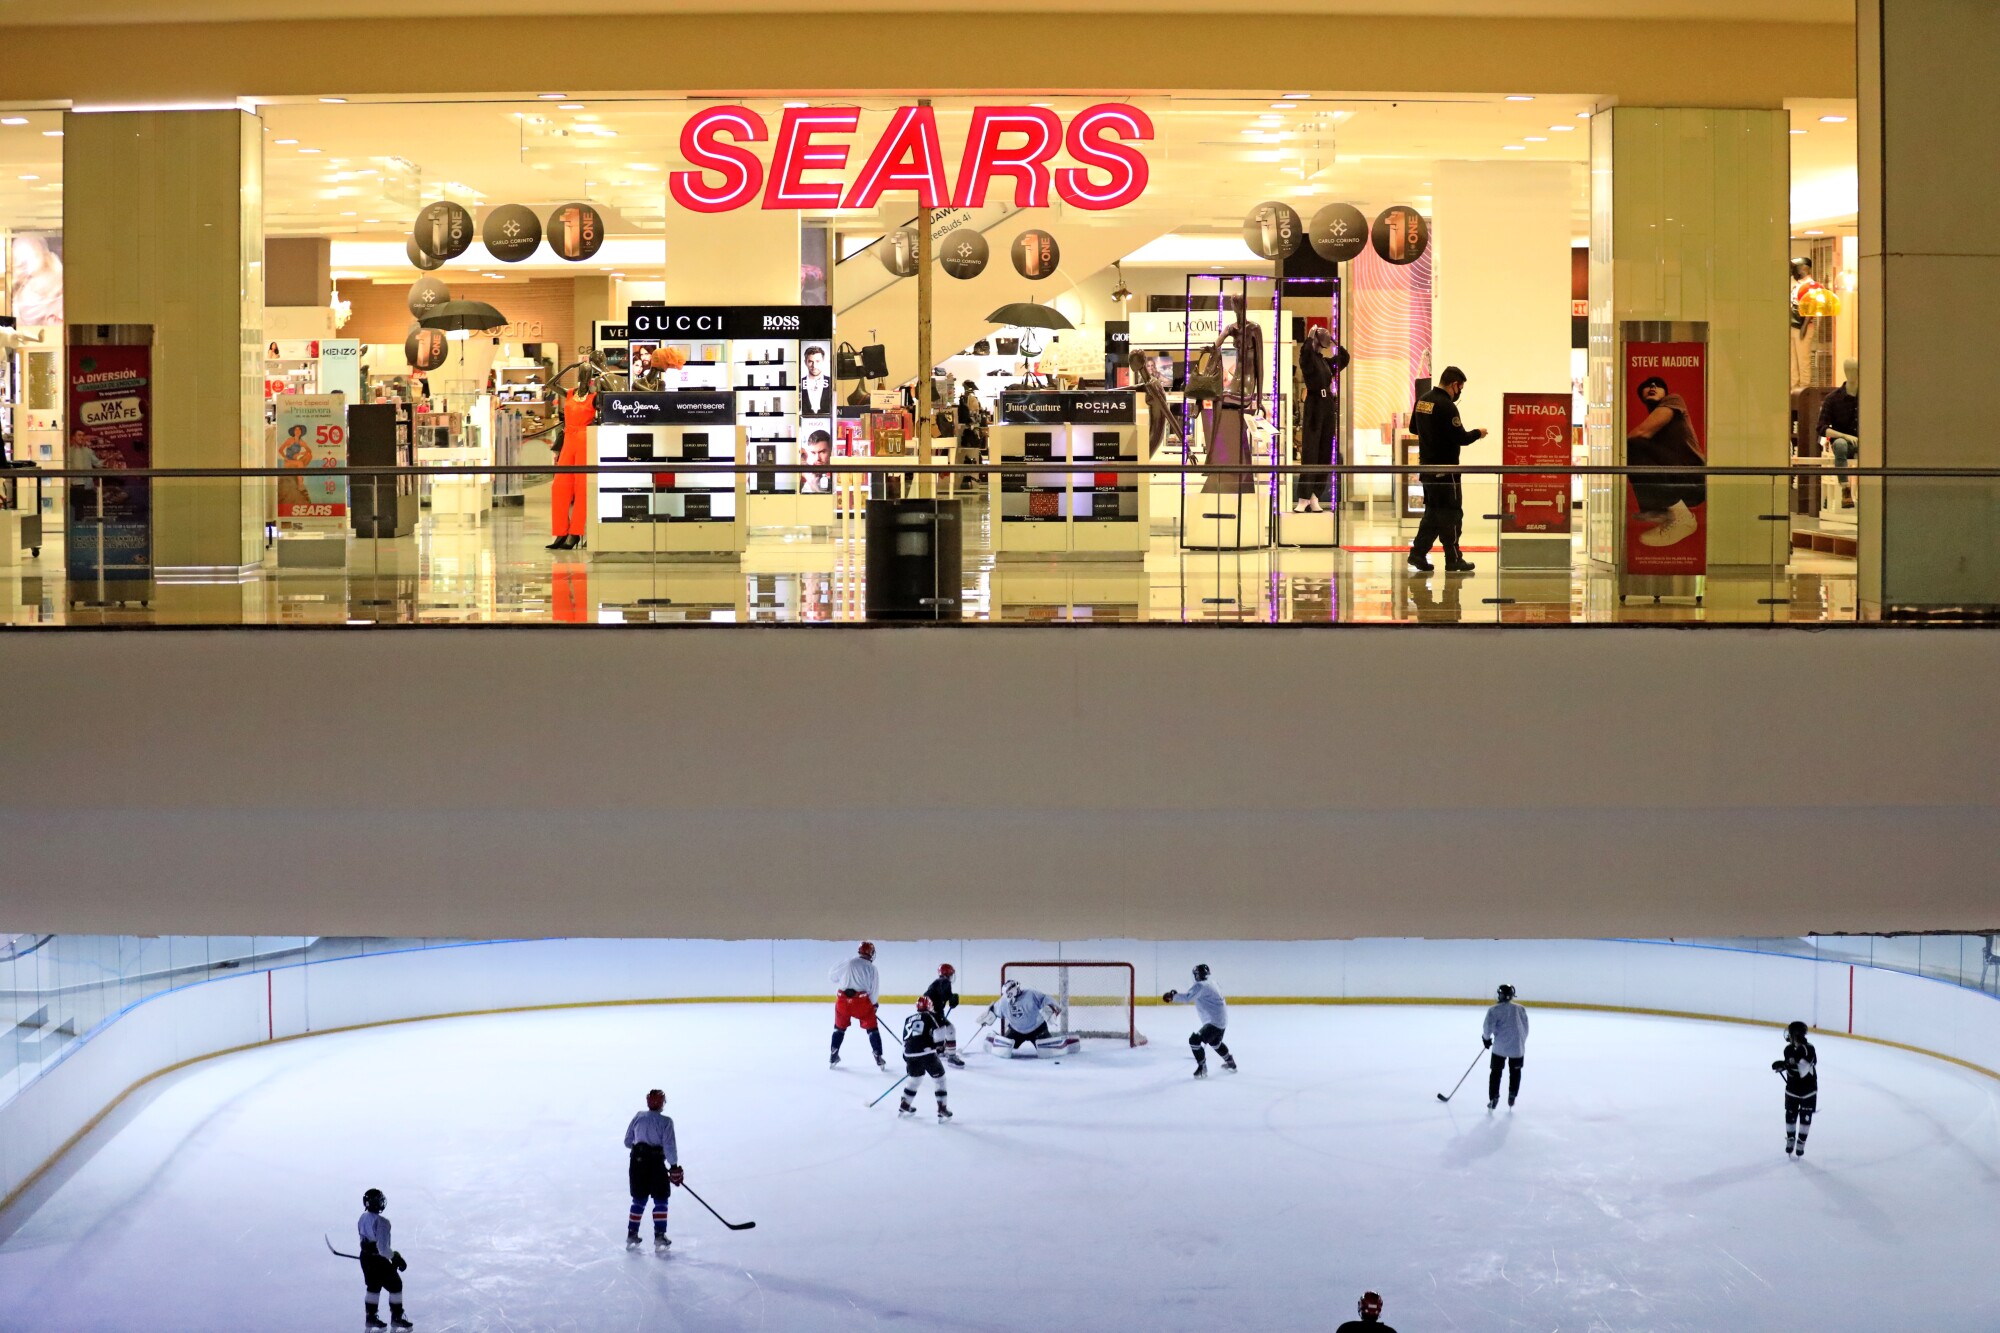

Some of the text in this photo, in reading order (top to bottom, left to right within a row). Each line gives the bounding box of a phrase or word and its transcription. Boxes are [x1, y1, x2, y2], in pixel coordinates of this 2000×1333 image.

[669, 102, 1155, 213] SEARS
[451, 211, 462, 239] ONE
[583, 212, 594, 240] ONE
[1280, 210, 1291, 238] ONE
[1408, 214, 1418, 243] ONE
[1041, 237, 1050, 262] ONE
[636, 316, 722, 331] GUCCI
[763, 316, 800, 326] BOSS
[432, 334, 441, 355] ONE
[1632, 356, 1699, 367] STEVE MADDEN
[73, 368, 136, 384] LA DIVERSIÓN
[101, 401, 122, 412] YAK
[612, 400, 633, 414] Pepe
[1005, 403, 1061, 412] Juicy Couture
[1509, 404, 1566, 416] ENTRADA
[87, 408, 136, 422] SANTA FE
[322, 457, 337, 468] 20
[324, 481, 336, 492] 18
[292, 505, 332, 516] SEARS
